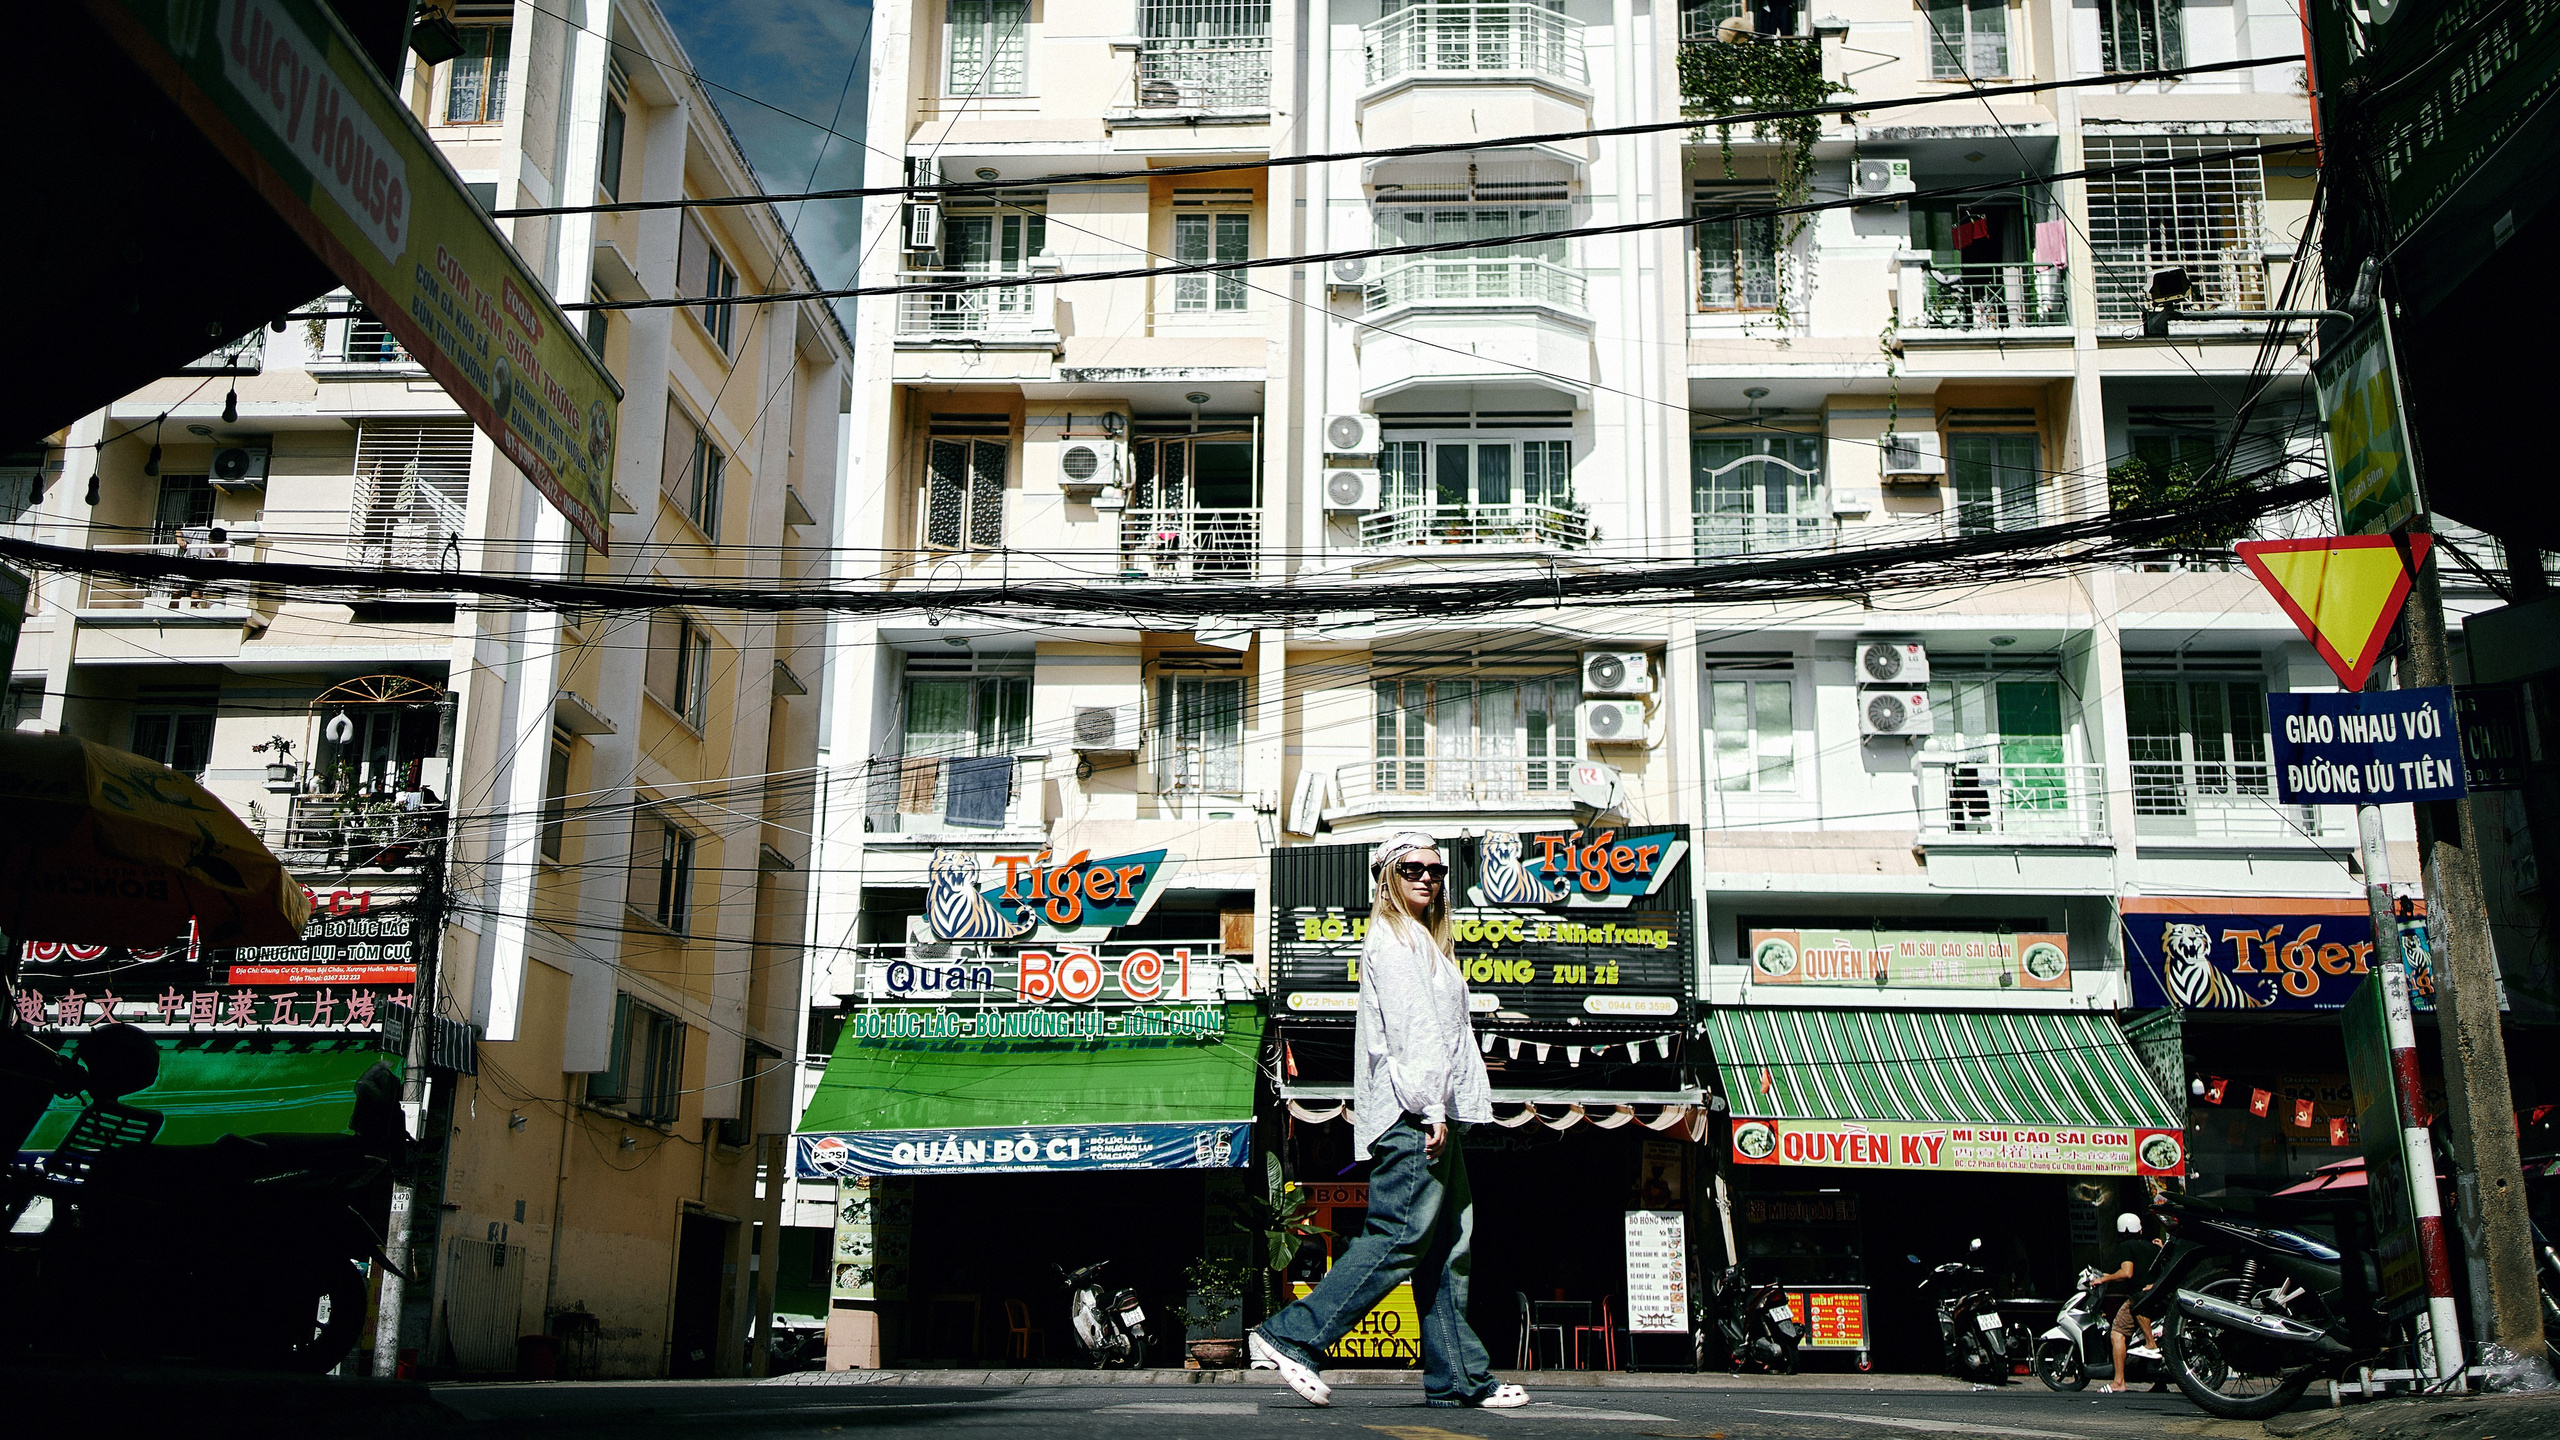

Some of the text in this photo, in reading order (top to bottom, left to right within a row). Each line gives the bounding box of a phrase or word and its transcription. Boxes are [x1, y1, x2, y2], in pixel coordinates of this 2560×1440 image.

[230, 0, 403, 244] Lucy House
[415, 262, 440, 303] CƠM
[440, 290, 455, 321] GÀ
[455, 306, 475, 344] KHO
[505, 284, 537, 336] FOODS
[412, 293, 490, 397] BÚN THỊT NƯỚNG
[436, 243, 580, 434] CƠM TẤM SƯỜN TRỨNG
[510, 405, 533, 444] BÁNH
[534, 433, 546, 455] MÌ
[514, 377, 536, 418] BÁNH
[536, 406, 547, 428] MÌ
[548, 417, 564, 446] THỊT
[2349, 466, 2384, 503] Cách 50m
[2285, 714, 2334, 744] GIAO
[2337, 713, 2397, 744] NHAU
[2401, 701, 2442, 741] VỚI
[2287, 753, 2455, 794] ĐƯỜNG ƯU TIÊN
[1533, 829, 1660, 893] Tiger
[329, 890, 371, 916] C1
[993, 848, 1147, 924] Tiger
[1304, 912, 1344, 941] BÒ
[1556, 922, 1669, 949] NhaTrang
[260, 967, 280, 975] Chung
[316, 966, 327, 974] Bội
[327, 966, 345, 974] Châu,
[346, 965, 366, 974] Xương
[367, 965, 384, 973] Huân,
[399, 965, 416, 973] Trang
[311, 940, 413, 964] LỤI TÔM CUỘ
[1455, 953, 1536, 983] ƯỚNG
[1552, 965, 1587, 984] ZUI
[1803, 938, 1867, 982] QUYỀN
[2221, 923, 2374, 998] Tiger
[289, 974, 303, 982] Điện
[303, 974, 323, 982] Thoại:
[886, 944, 1192, 1004] Quán BÒ C1
[1305, 998, 1492, 1008] C2 Phan NT
[1608, 1000, 1671, 1011] 0944 66 3598
[855, 1005, 1222, 1042] BÒ LÚC LẮC BÒ NƯỚNG LỤI TÔM CUỘN
[891, 1132, 1081, 1165] QUÁN BÒ C1
[1783, 1122, 1948, 1166] QUYỀN KÝ
[1952, 1127, 1973, 1142] MÌ
[2056, 1129, 2086, 1145] SÀI
[2091, 1130, 2129, 1146] GÒN
[1967, 1160, 1977, 1168] C2
[1977, 1160, 1995, 1169] Phan
[1996, 1160, 2009, 1170] Bội
[2029, 1161, 2051, 1171] Chung
[2062, 1162, 2075, 1172] Chợ
[2095, 1163, 2109, 1171] Nha
[2110, 1163, 2130, 1173] Trang
[1315, 1185, 1349, 1203] BÒ
[1629, 1213, 1680, 1227] BÒ HỒNG NGỌC
